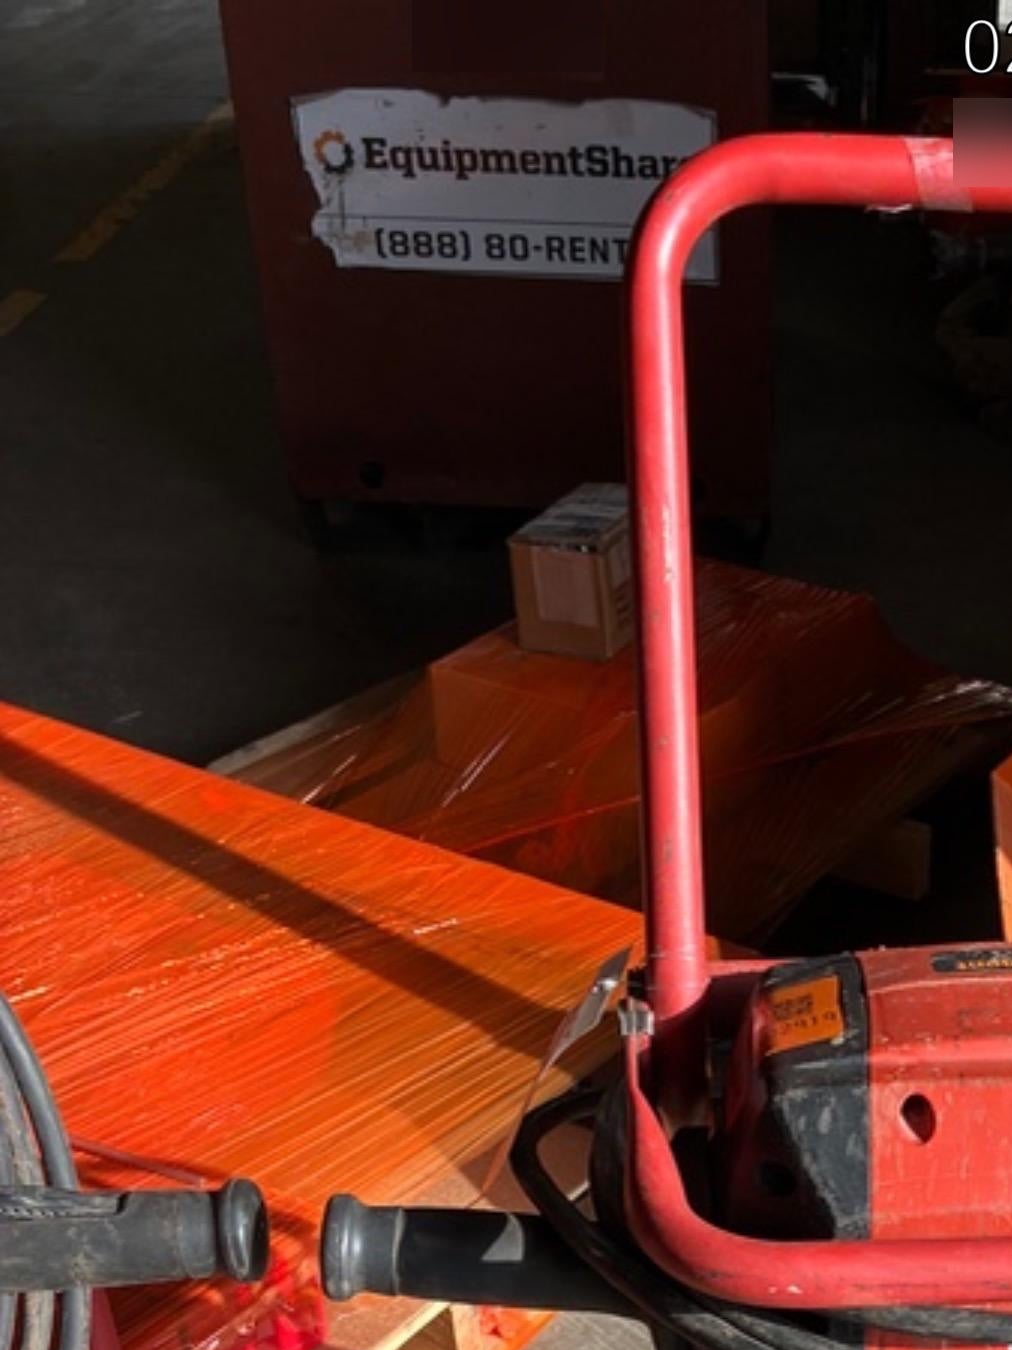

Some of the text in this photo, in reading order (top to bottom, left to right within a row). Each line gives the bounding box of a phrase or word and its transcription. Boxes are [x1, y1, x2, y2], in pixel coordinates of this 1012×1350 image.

[362, 136, 688, 180] EquipmentShar
[374, 228, 629, 265] (888) 80-RENT
